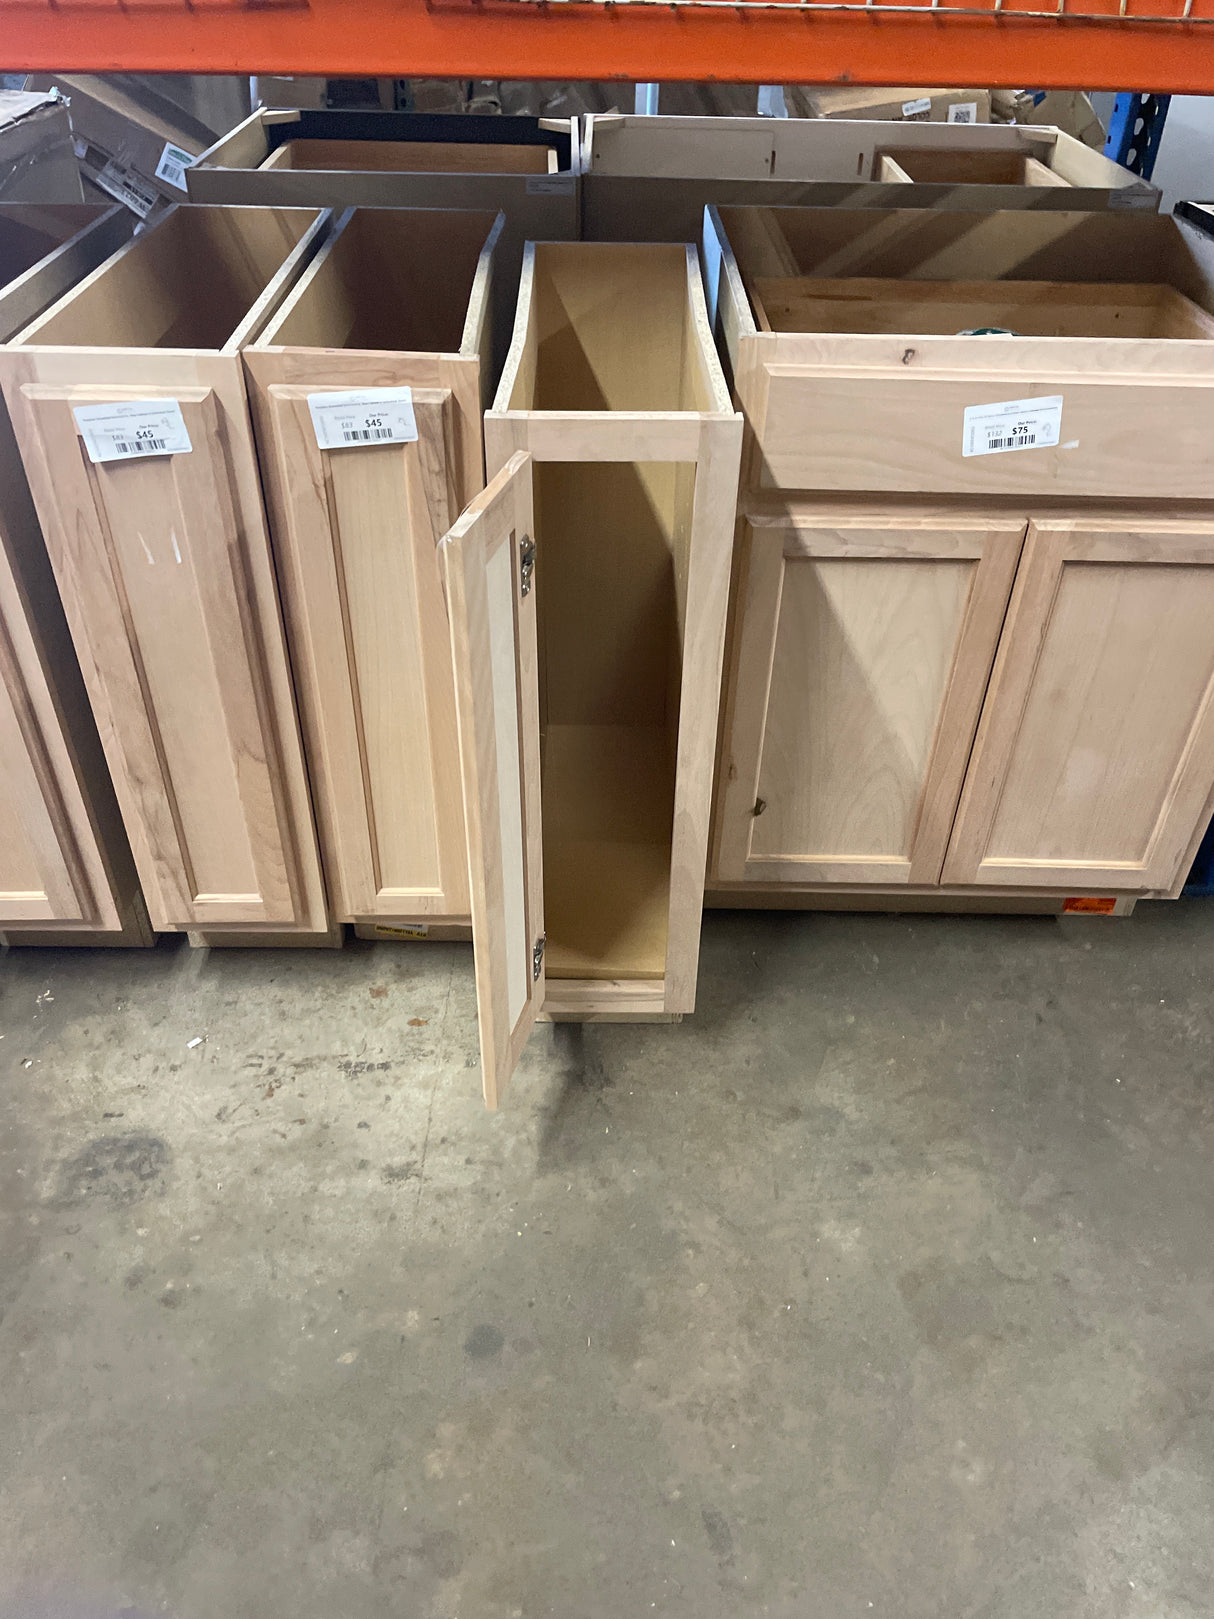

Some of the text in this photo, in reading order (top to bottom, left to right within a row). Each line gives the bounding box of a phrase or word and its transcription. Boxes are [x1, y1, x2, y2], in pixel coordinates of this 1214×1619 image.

[365, 418, 382, 428] $45
[136, 430, 154, 440] $45
[1012, 425, 1029, 436] $75
